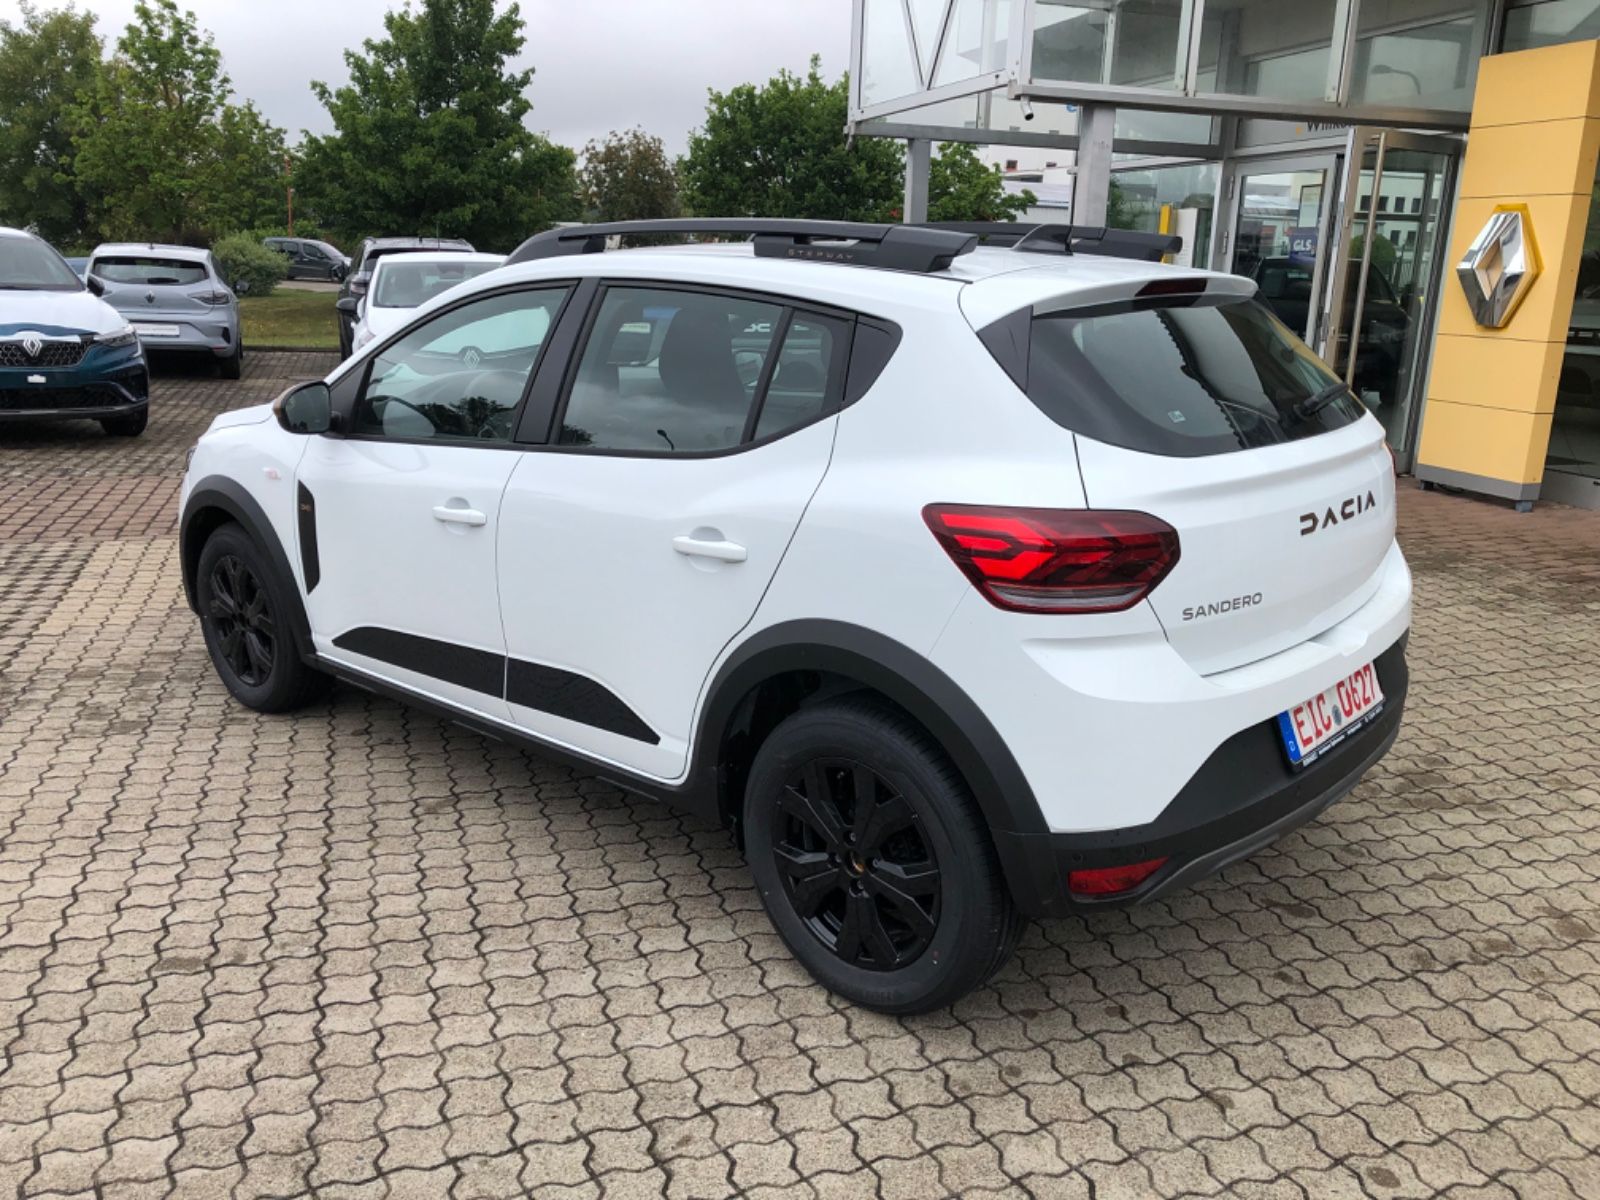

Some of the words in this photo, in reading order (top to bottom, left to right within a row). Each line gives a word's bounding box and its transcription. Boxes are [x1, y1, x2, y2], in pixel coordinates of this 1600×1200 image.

[1299, 489, 1376, 536] DACIA
[1182, 592, 1263, 621] SANDERO
[1293, 692, 1333, 748] EIC
